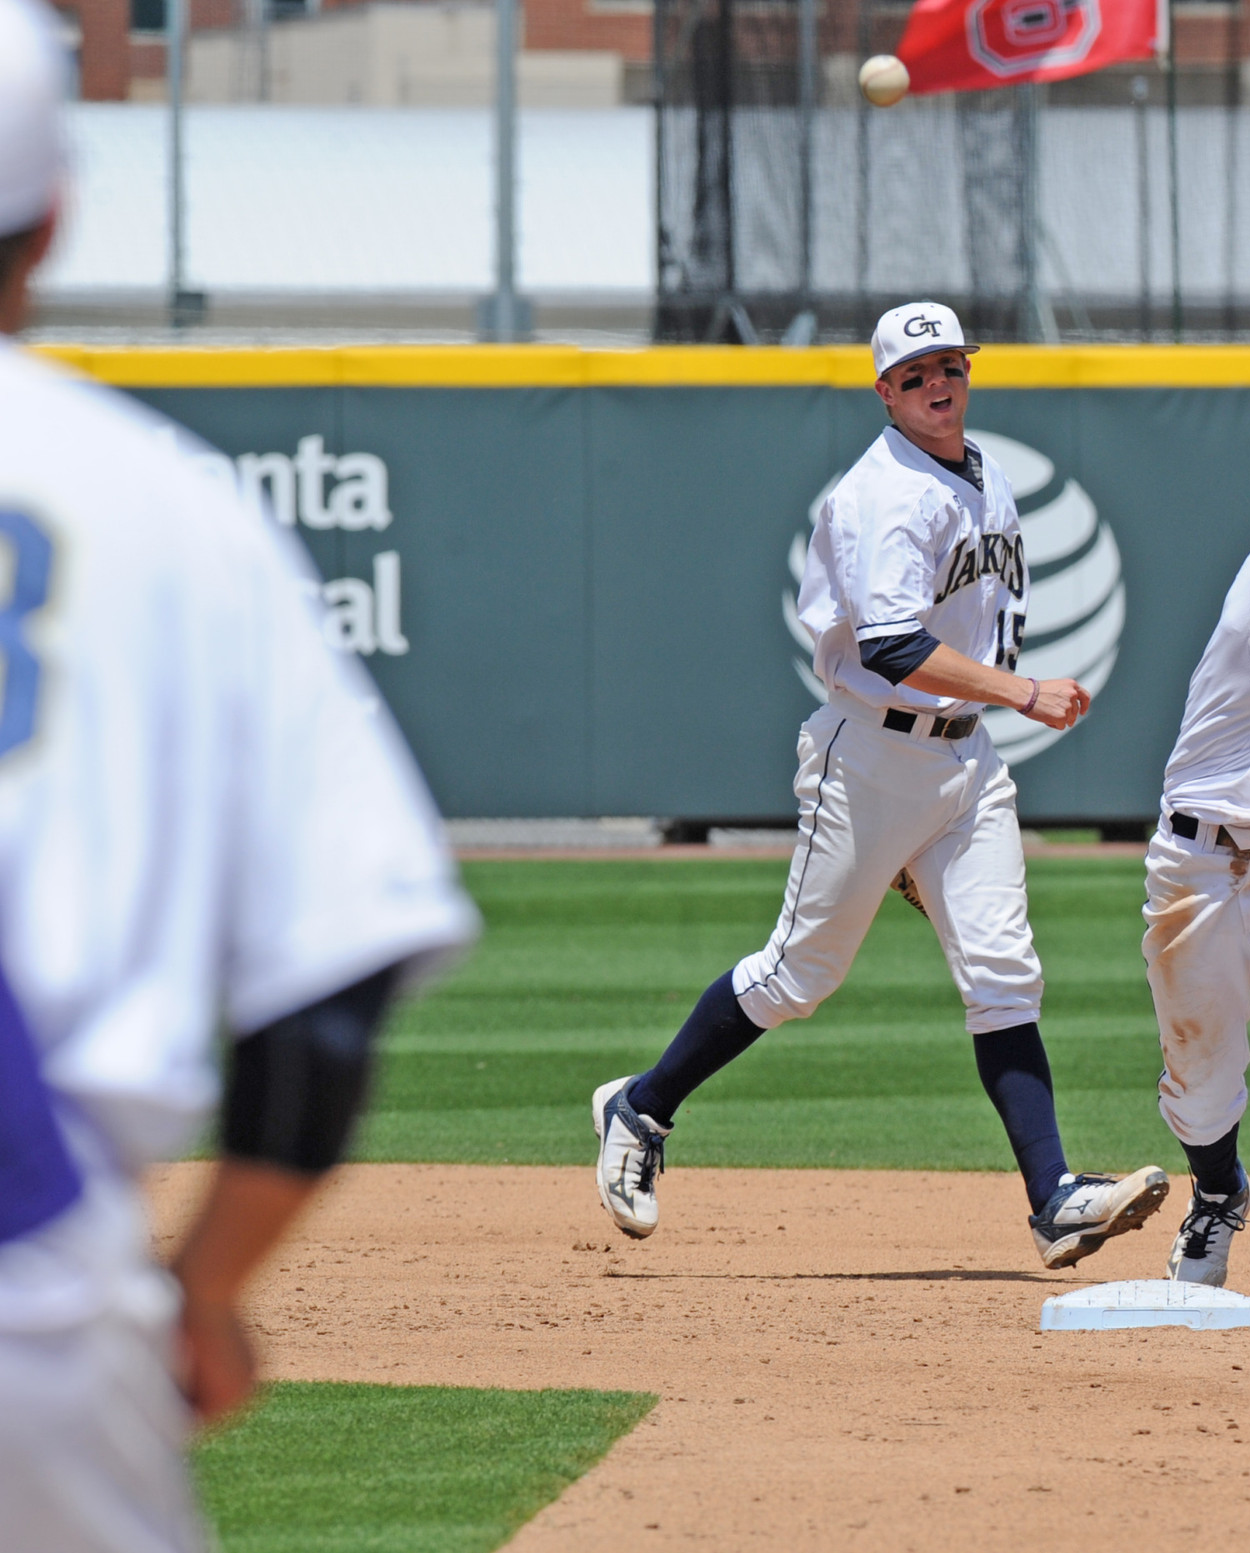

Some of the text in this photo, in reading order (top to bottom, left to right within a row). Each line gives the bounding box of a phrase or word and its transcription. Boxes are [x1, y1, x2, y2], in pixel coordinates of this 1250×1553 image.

[904, 314, 942, 337] GT
[236, 433, 393, 531] nta
[312, 549, 410, 656] al
[995, 607, 1026, 671] 15
